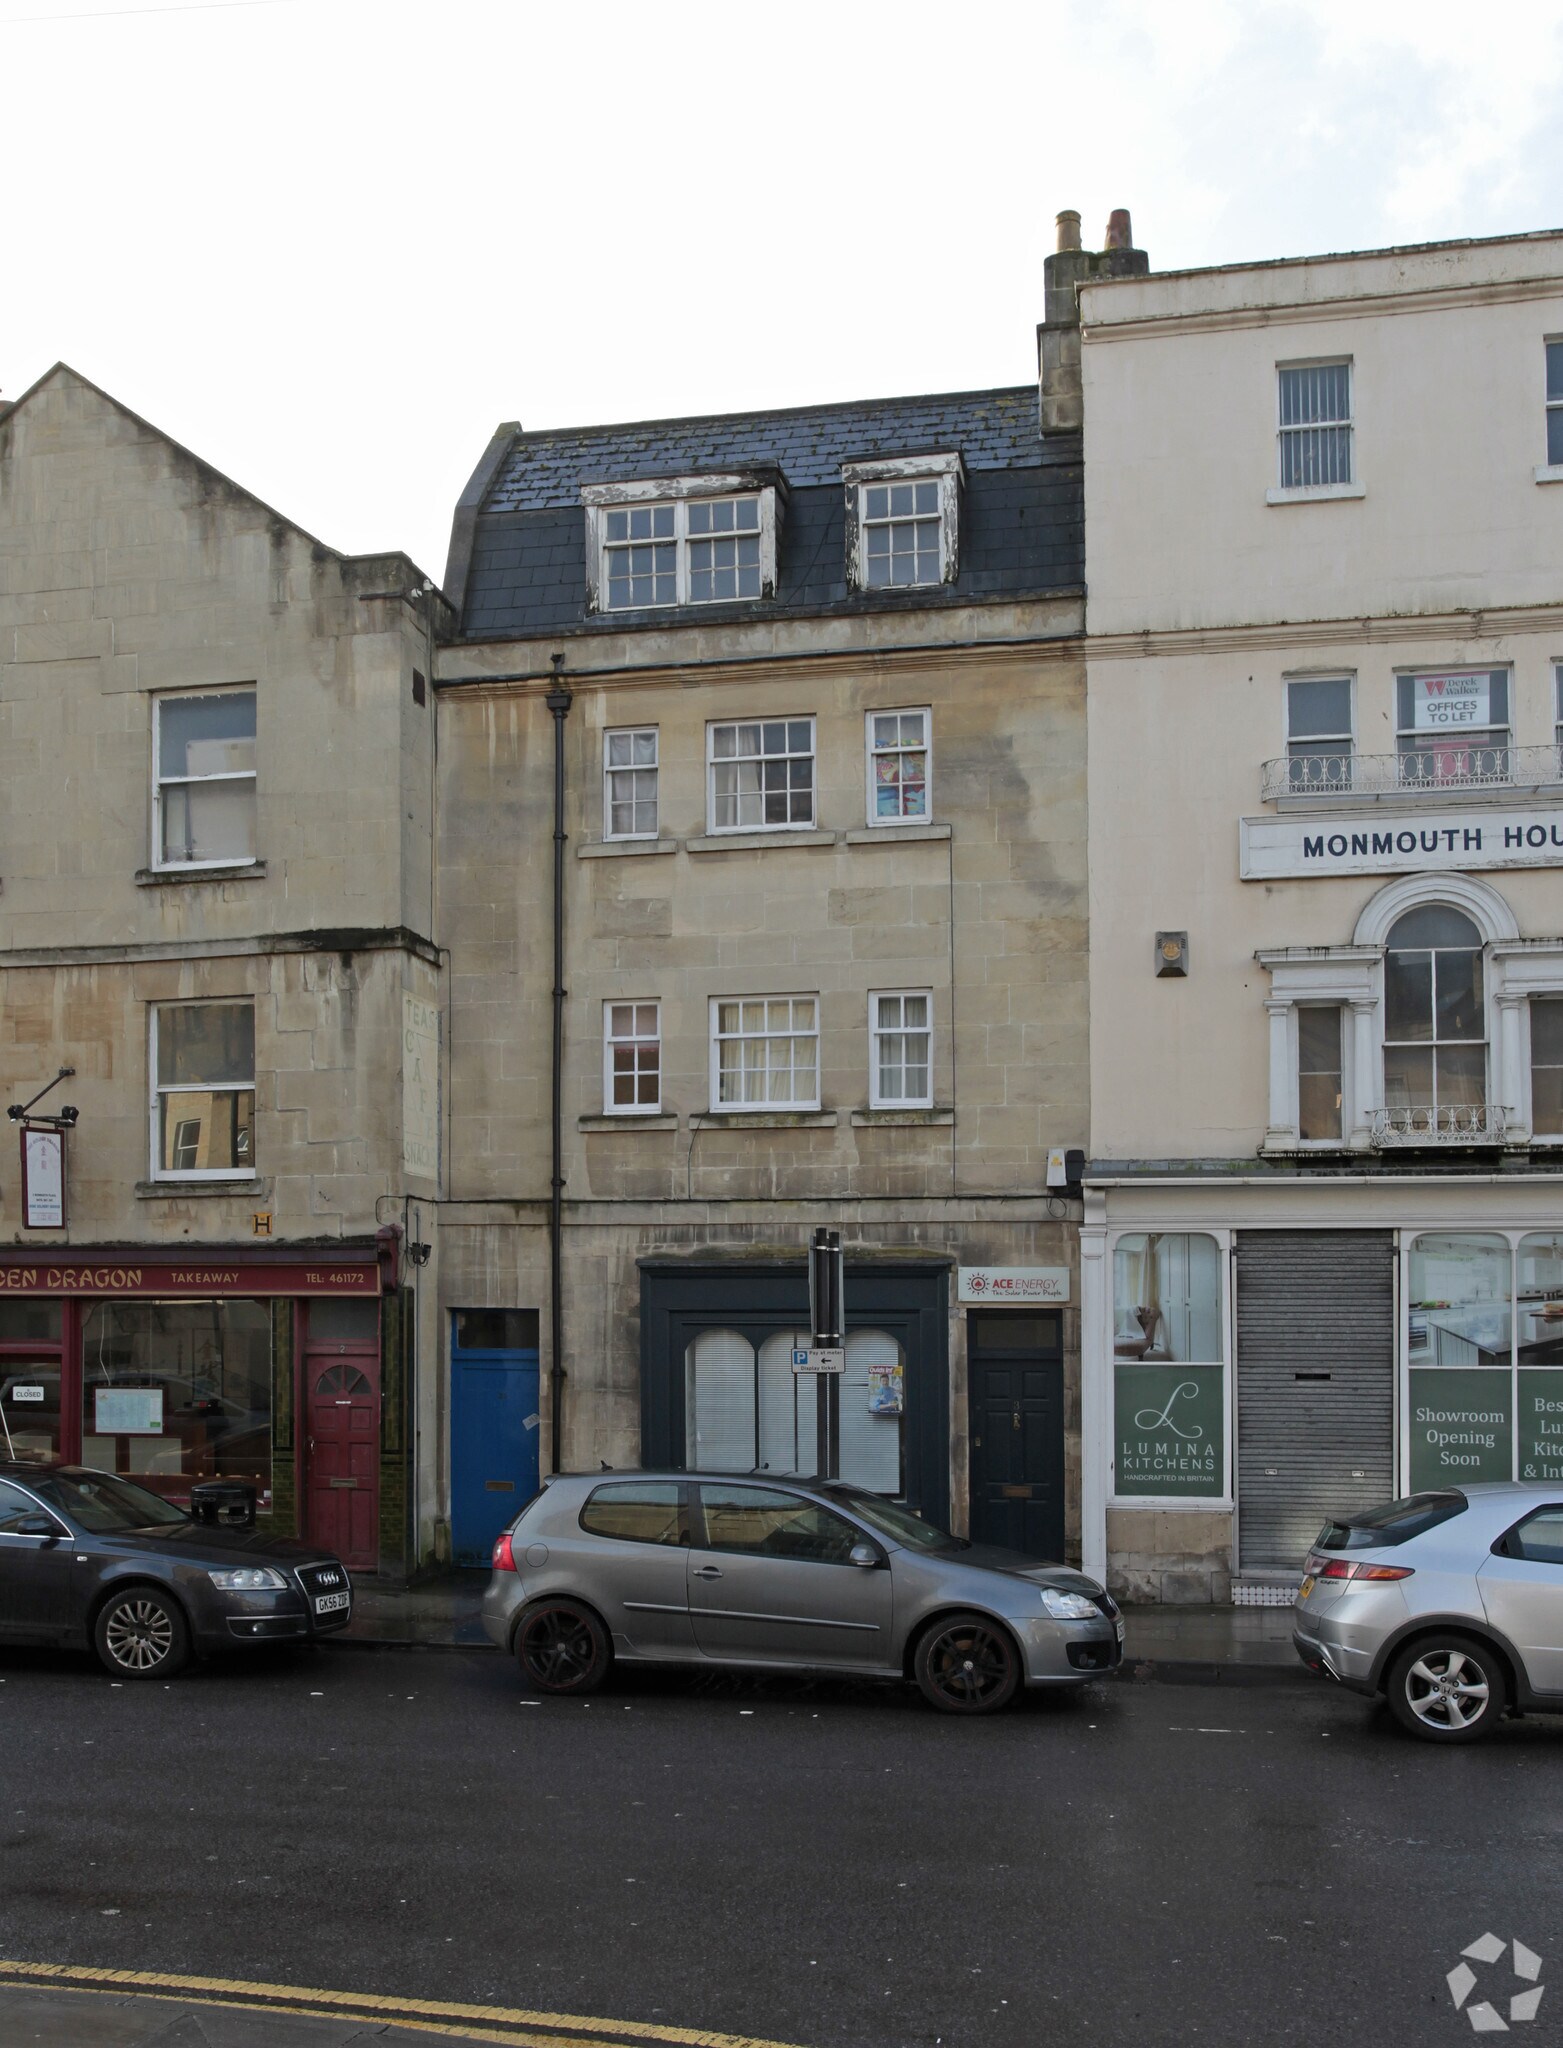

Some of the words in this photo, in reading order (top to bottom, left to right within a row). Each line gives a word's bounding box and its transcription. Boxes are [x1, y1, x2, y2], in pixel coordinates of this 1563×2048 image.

[1448, 677, 1477, 687] Derek
[1446, 686, 1480, 696] Walker
[1427, 700, 1477, 712] OFFICES
[1429, 713, 1449, 723] TO
[1452, 711, 1475, 722] LET
[1303, 827, 1482, 858] MONMOUTH
[1504, 824, 1563, 848] HOU
[253, 1214, 271, 1233] H
[47, 1269, 142, 1288] DRAGON
[171, 1272, 240, 1283] TAKEAWAY
[306, 1273, 325, 1283] TEL:
[329, 1273, 364, 1283] 461172
[992, 1279, 1013, 1289] ACE
[1015, 1279, 1059, 1289] ENERGY
[1043, 1289, 1062, 1298] People
[340, 1345, 345, 1353] 2
[796, 1352, 806, 1363] P
[1416, 1407, 1504, 1423] Showroom
[1541, 1420, 1563, 1434] Lu
[1426, 1429, 1495, 1448] Opening
[1123, 1442, 1214, 1456] LUMINA
[1123, 1458, 1214, 1470] KITCHENS
[1440, 1451, 1480, 1466] Soon
[1523, 1463, 1537, 1478] &
[1124, 1474, 1176, 1482] HANDCRAFTED
